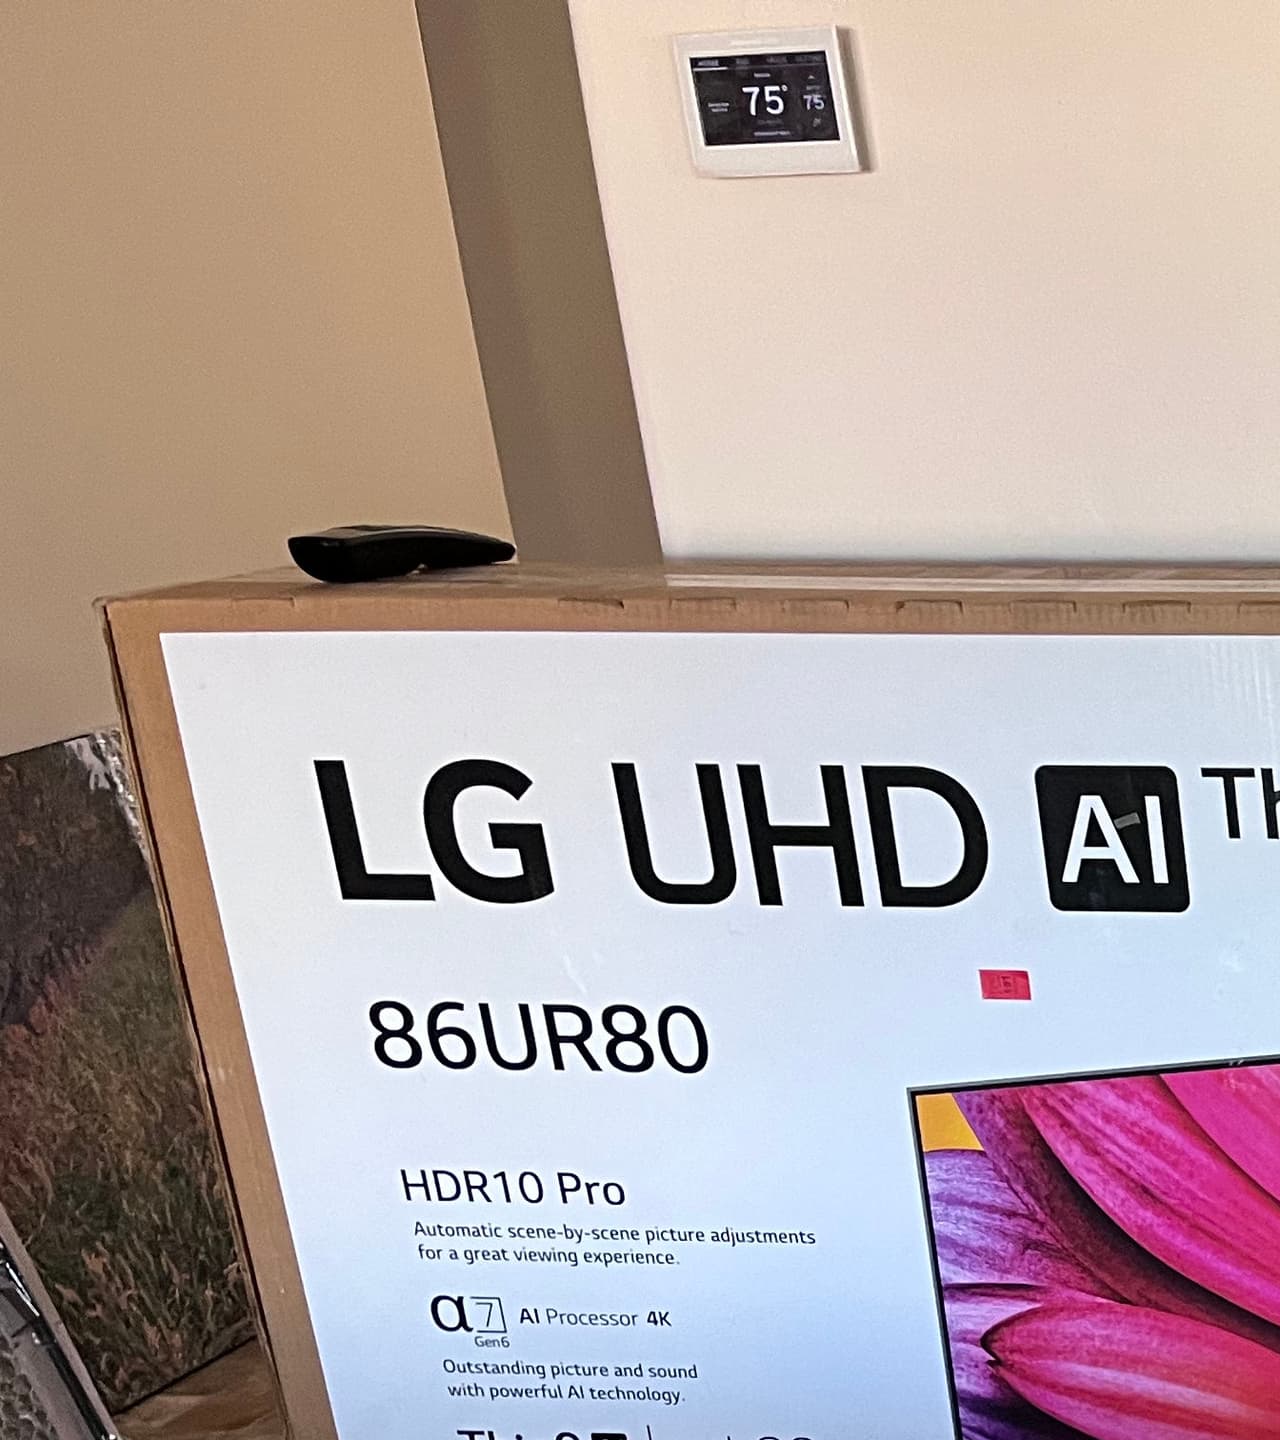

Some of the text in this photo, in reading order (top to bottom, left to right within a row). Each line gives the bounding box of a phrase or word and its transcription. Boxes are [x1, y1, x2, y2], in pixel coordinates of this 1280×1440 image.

[803, 95, 825, 111] 75
[313, 759, 554, 903] LG
[611, 762, 989, 907] UHD
[1061, 795, 1169, 884] AI
[368, 1000, 710, 1074] 86UR80
[400, 1169, 626, 1206] HDR10 Pro
[413, 1221, 816, 1246] Automatic scene-by-scene picture adjustments
[418, 1244, 680, 1268] for a great viewing experience.
[519, 1308, 672, 1328] AI Processor 4K
[474, 1336, 510, 1350] Gen6
[442, 1359, 698, 1380] Outstanding picture and sound
[448, 1382, 686, 1406] with powerful AI technology.
